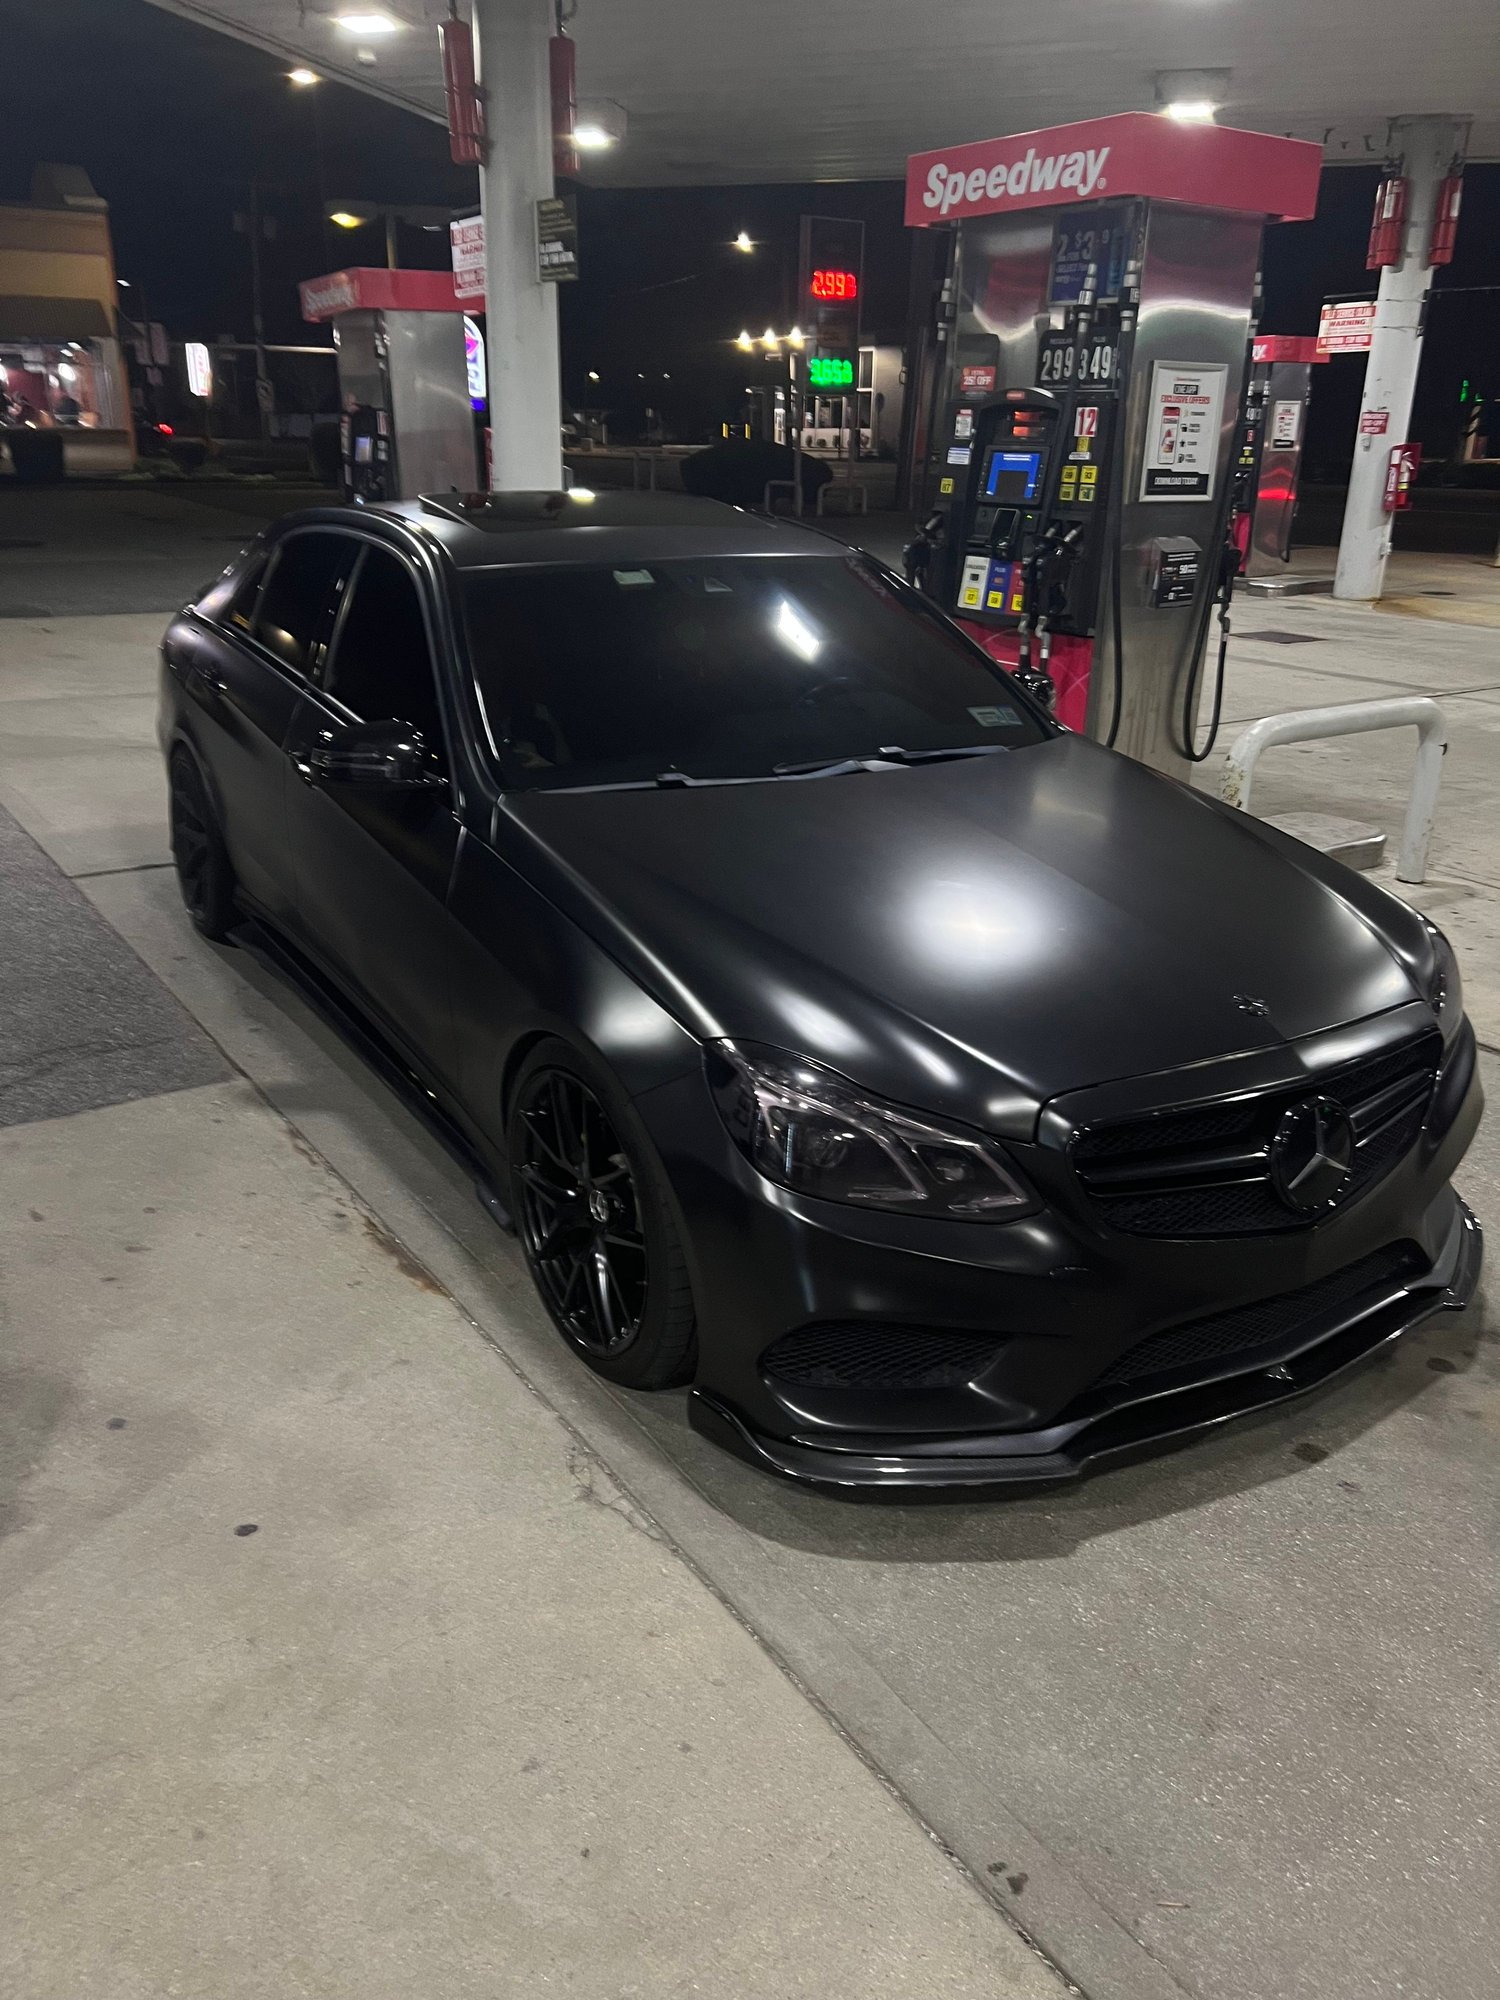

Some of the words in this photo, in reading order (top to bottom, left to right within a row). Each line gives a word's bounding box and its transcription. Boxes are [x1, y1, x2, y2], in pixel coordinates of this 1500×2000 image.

[923, 147, 1110, 214] Speedway
[1041, 346, 1074, 380] 299
[977, 376, 992, 385] OFF
[1078, 408, 1097, 435] 12
